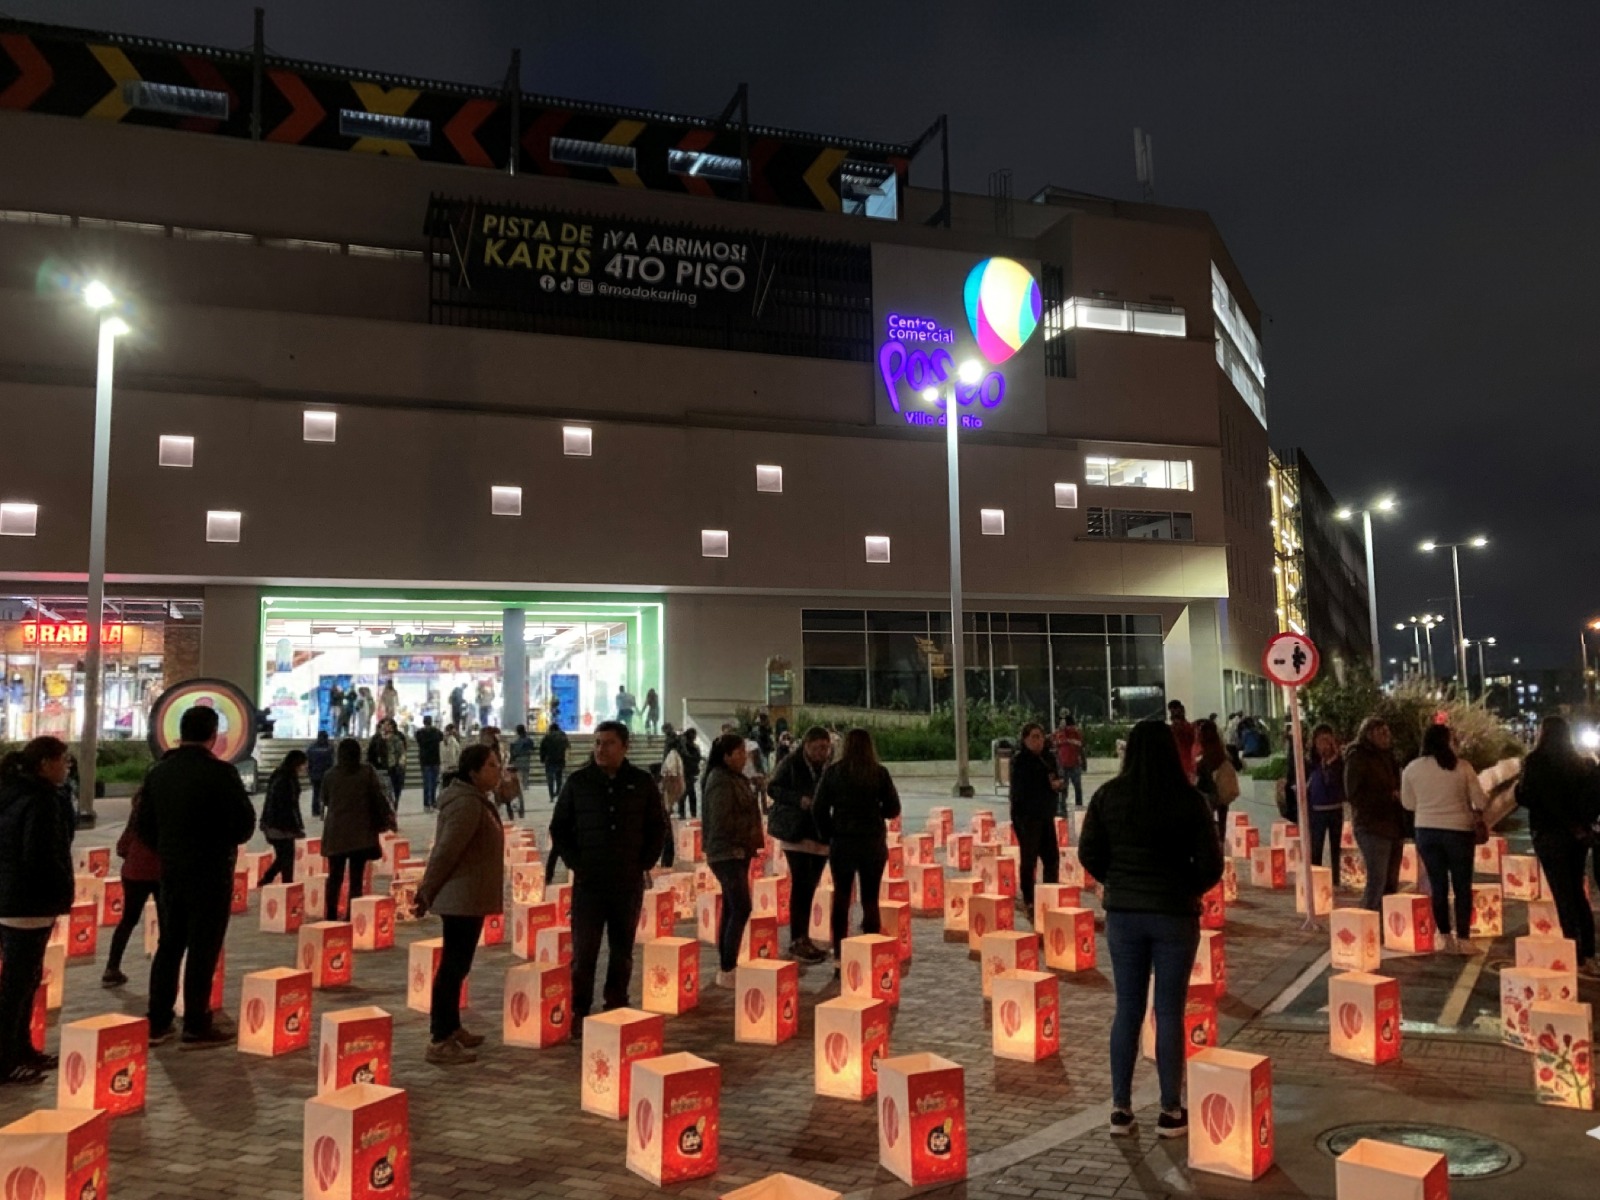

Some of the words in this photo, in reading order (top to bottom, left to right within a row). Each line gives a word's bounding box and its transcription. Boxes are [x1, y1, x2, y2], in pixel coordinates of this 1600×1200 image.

[482, 213, 551, 240] PISTA
[560, 222, 594, 245] DE
[484, 238, 592, 275] KARTS
[602, 230, 638, 249] ¡YA
[646, 235, 748, 261] ABRIMOS!
[604, 253, 665, 283] 4TO
[676, 260, 746, 293] PISO
[888, 314, 936, 330] Centro
[888, 329, 954, 343] comercial
